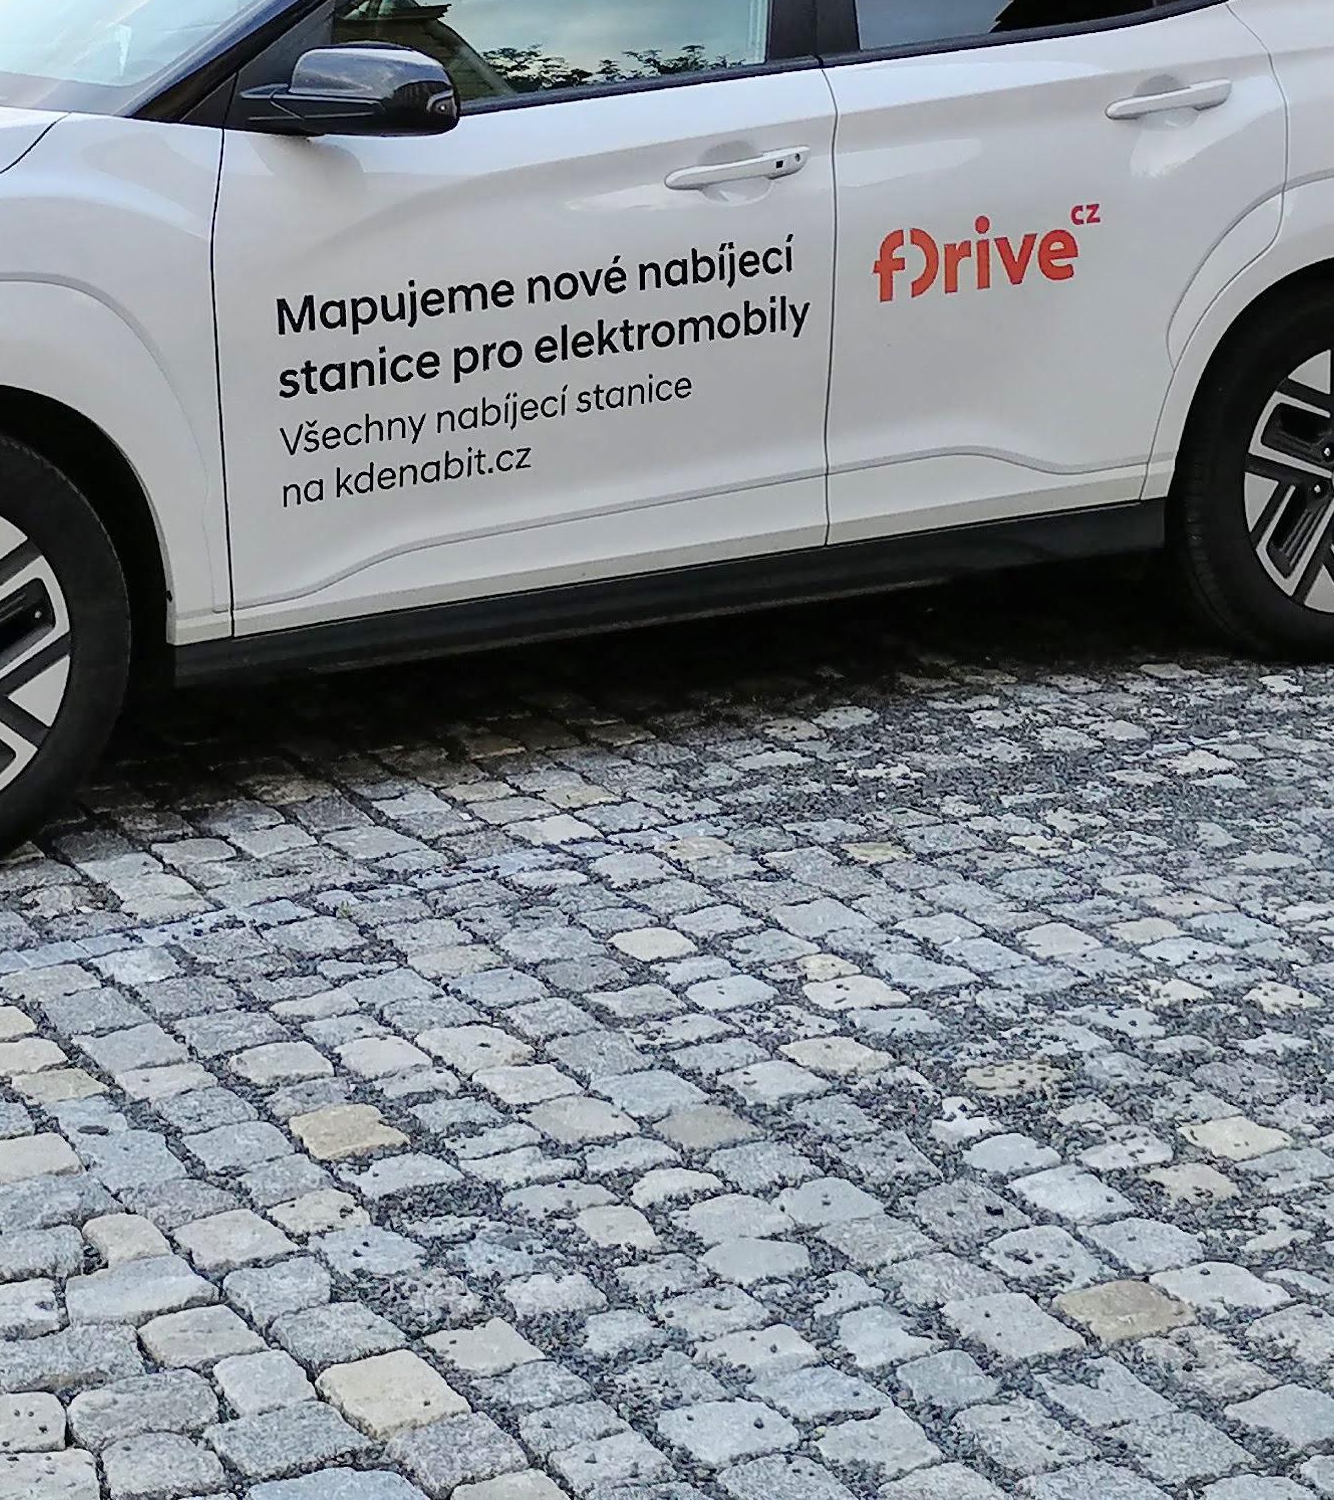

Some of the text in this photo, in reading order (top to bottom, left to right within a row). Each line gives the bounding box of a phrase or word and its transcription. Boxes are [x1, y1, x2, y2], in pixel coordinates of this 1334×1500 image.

[276, 233, 795, 337] Mapujeme nové nabíjecí
[277, 295, 812, 399] stanice pro elektromobily
[278, 373, 694, 456] Všechny nabíjecí stanice
[282, 446, 533, 508] na kdenabit.cz
